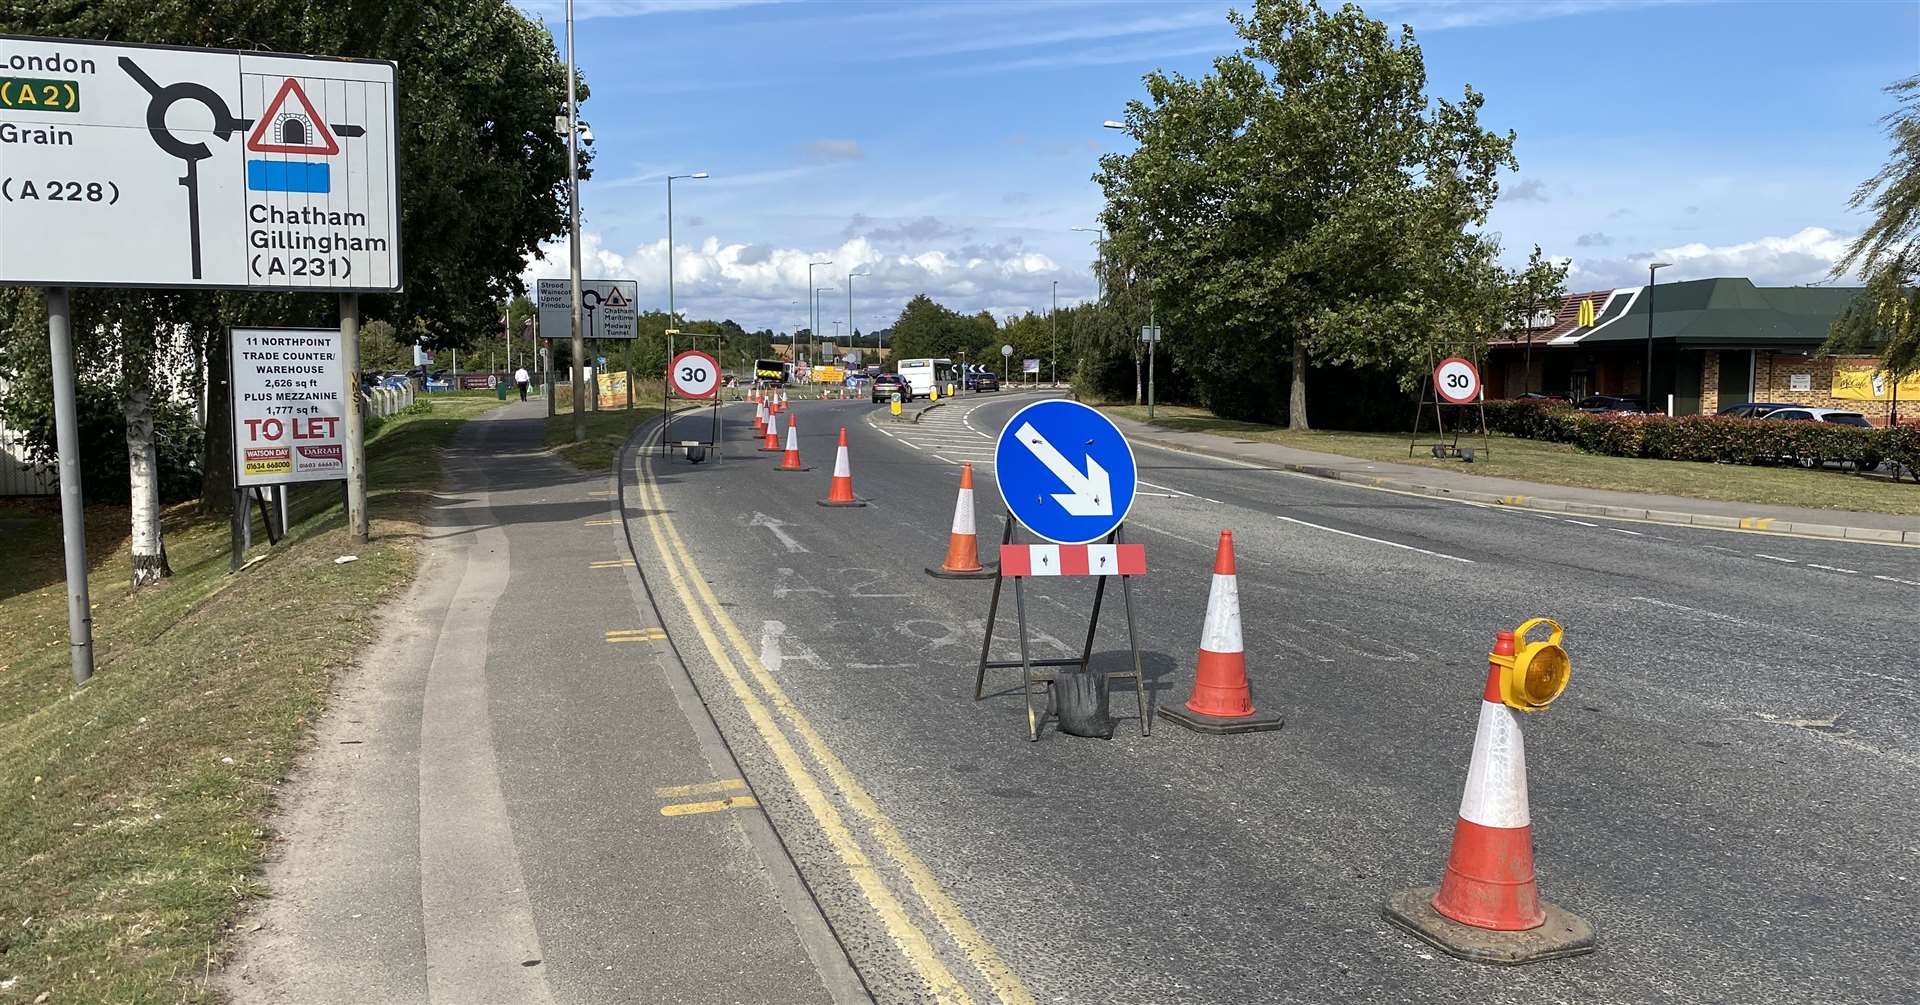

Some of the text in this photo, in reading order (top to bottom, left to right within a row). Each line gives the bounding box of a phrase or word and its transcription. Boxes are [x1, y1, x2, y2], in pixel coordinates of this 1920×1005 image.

[0, 123, 73, 146] Grain
[249, 204, 366, 226] Chatham
[250, 230, 387, 254] Gillingham
[246, 338, 331, 346] 11 NORTHPOINT
[243, 352, 336, 361] TRADE COUNTER/
[256, 366, 324, 374] WAREHOUSE
[681, 367, 707, 382] 30
[265, 379, 293, 389] 2,626
[310, 379, 318, 387] ft
[1447, 374, 1469, 388] 30
[244, 392, 337, 401] PLUS MEZZANINE
[266, 406, 293, 415] 1,777
[310, 405, 319, 414] ft
[244, 417, 340, 441] TO LET
[247, 448, 289, 457] WATSON DAY
